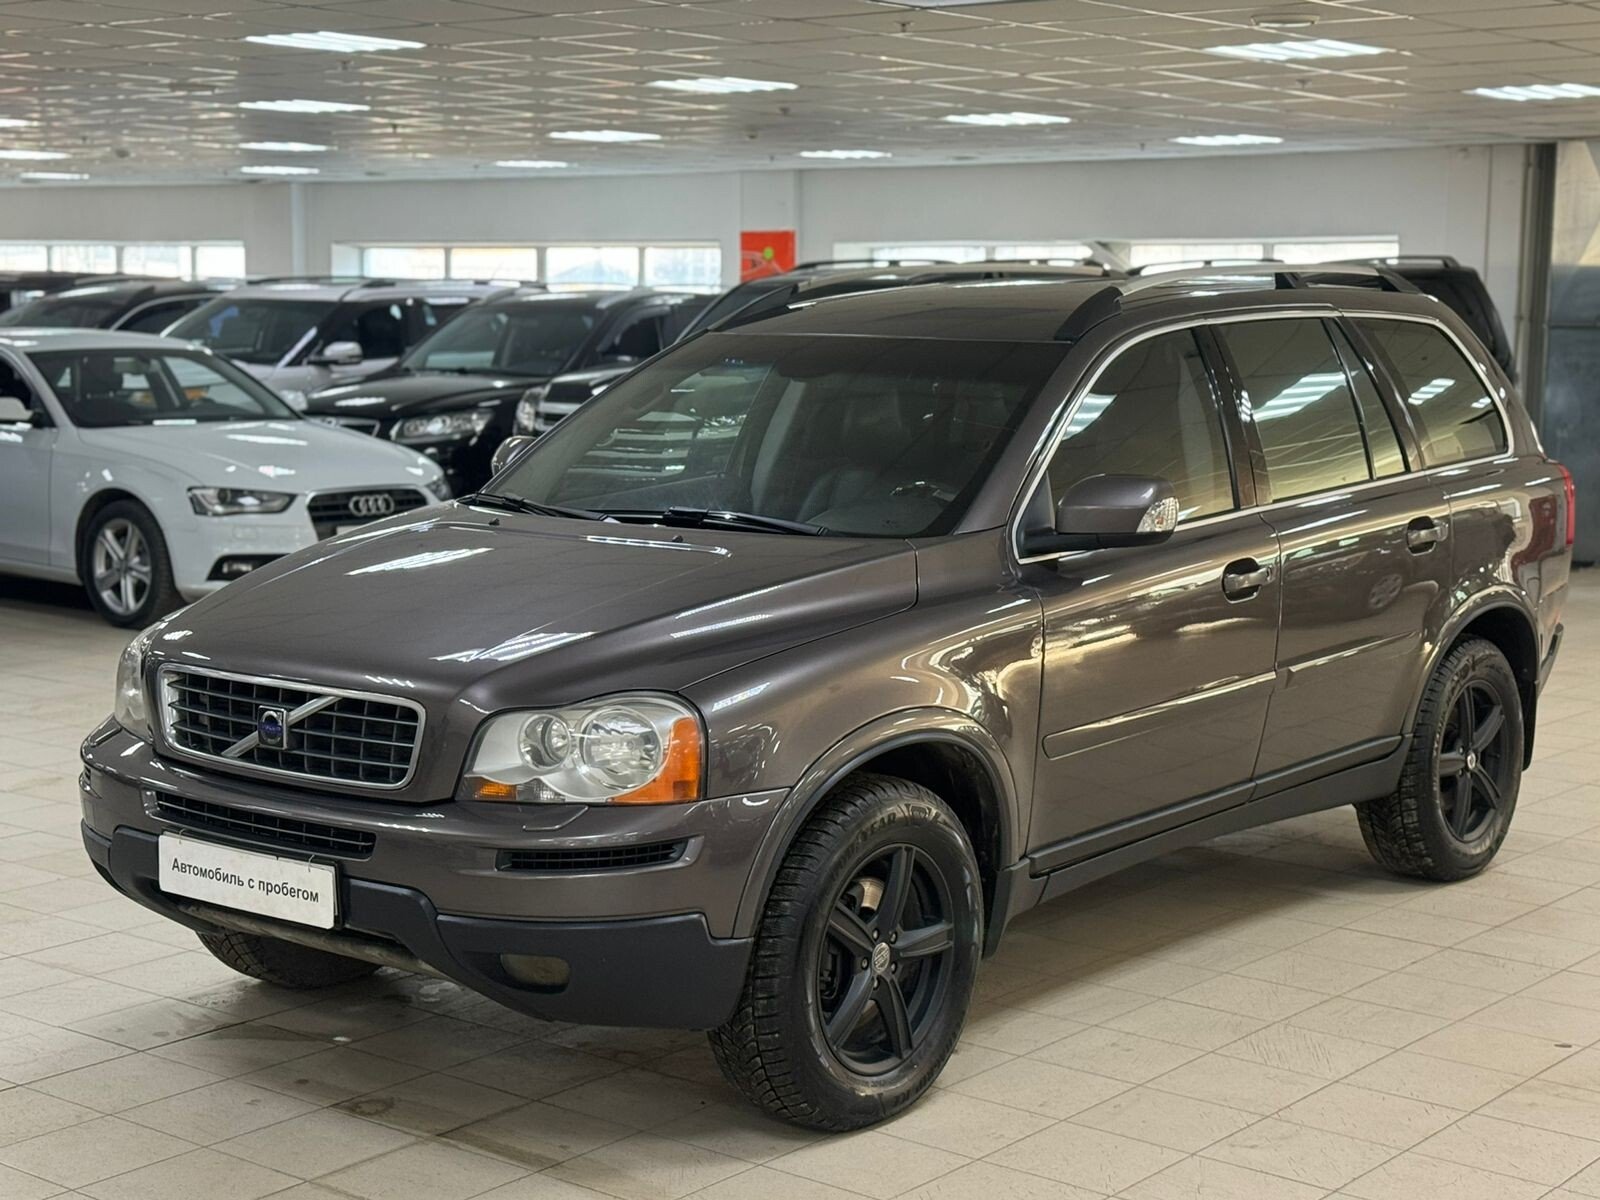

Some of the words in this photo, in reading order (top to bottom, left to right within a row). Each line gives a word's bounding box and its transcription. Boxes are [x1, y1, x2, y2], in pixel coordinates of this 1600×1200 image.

[171, 857, 245, 887] Автомобиль
[247, 878, 255, 889] с
[258, 880, 319, 903] пробегом
